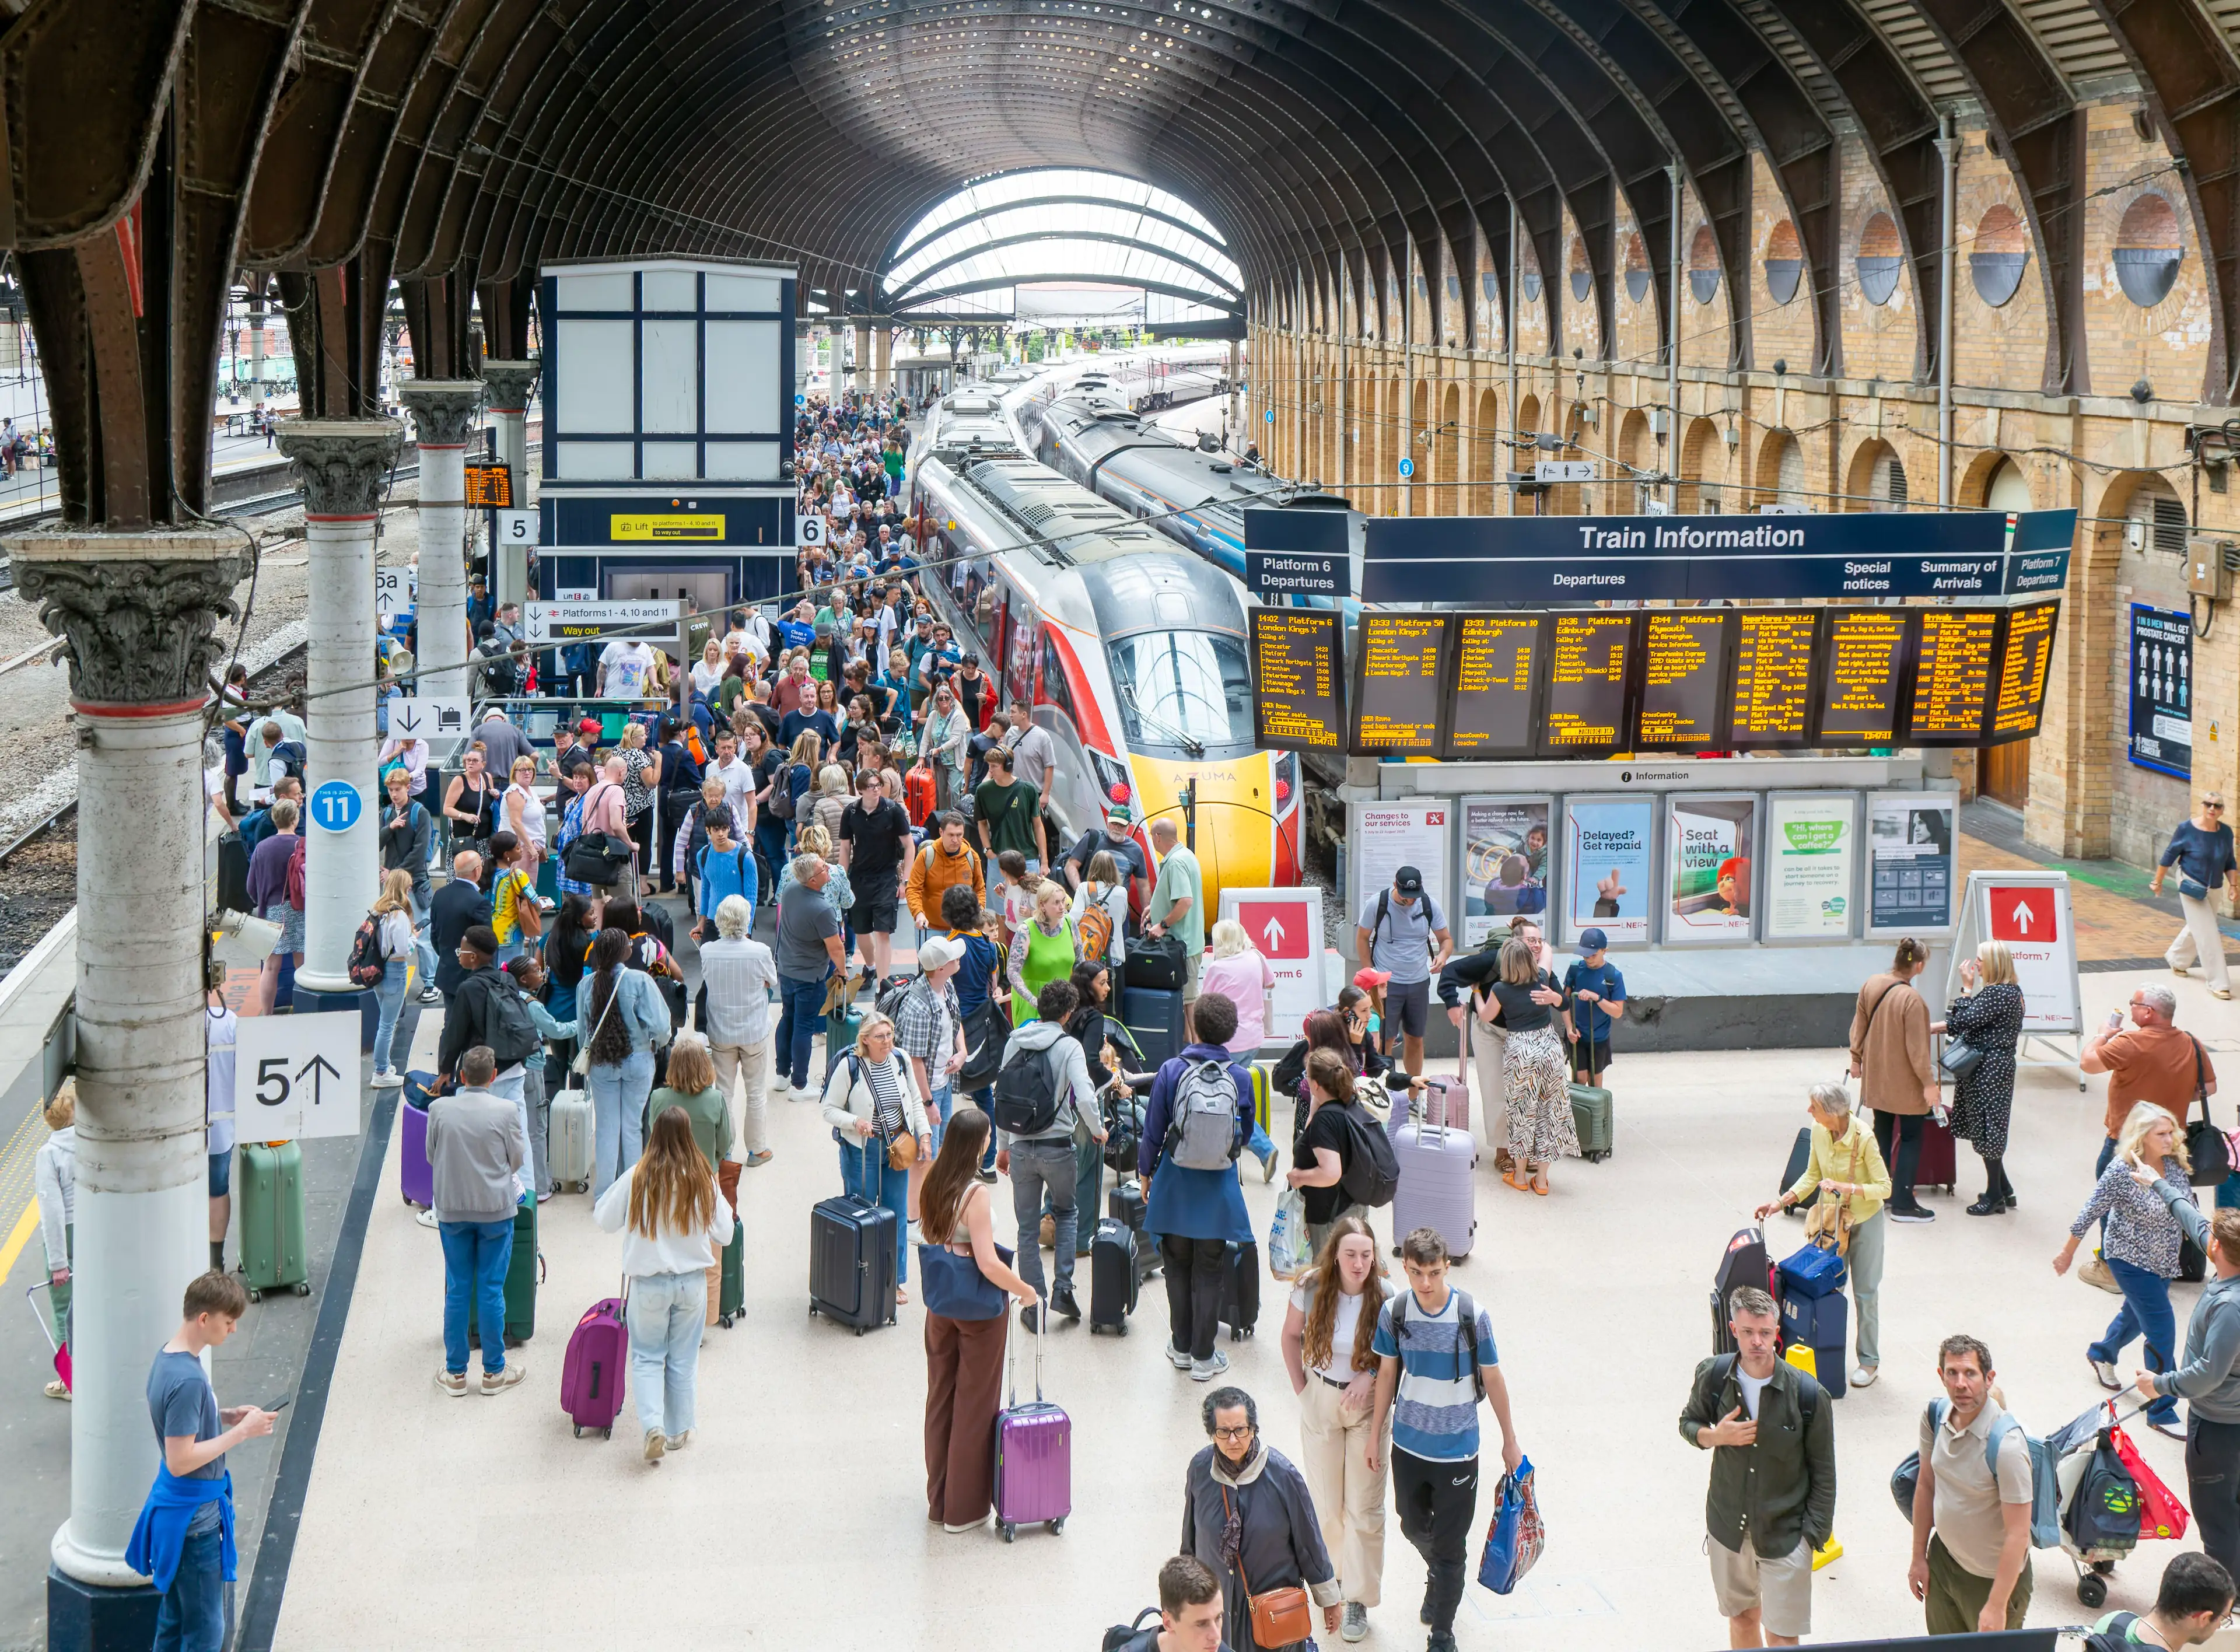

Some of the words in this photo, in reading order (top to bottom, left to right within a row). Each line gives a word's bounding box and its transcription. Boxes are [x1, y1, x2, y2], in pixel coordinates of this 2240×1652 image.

[1404, 464, 1409, 473] 9
[512, 520, 526, 537] 5
[802, 520, 819, 541] 6
[1579, 526, 1646, 549] Train
[1654, 525, 1805, 548] Information
[1263, 558, 1319, 571] Platform
[1323, 561, 1331, 572] 6
[1921, 561, 1980, 574] Summary
[1984, 561, 1997, 572] of
[2021, 558, 2053, 570] Platform
[2054, 556, 2060, 567] 7
[1845, 562, 1891, 576] Special
[377, 572, 397, 589] 5a
[1261, 574, 1334, 589] Departures
[1553, 574, 1625, 587] Departures
[1843, 579, 1889, 589] notices
[1933, 578, 1982, 589] Arrivals
[2017, 574, 2059, 587] Departures
[563, 609, 606, 617] Platforms
[621, 609, 629, 617] 4,
[691, 621, 708, 631] CREW
[1258, 615, 1279, 623] 14:02
[1289, 617, 1325, 626] Platform
[2137, 616, 2140, 624] 1
[2140, 617, 2146, 625] IN
[2151, 619, 2163, 629] MEN
[2164, 621, 2177, 632] WILL
[2178, 625, 2189, 635] GET
[563, 626, 583, 636] Way
[584, 626, 600, 635] out
[1258, 624, 1286, 632] London
[1289, 625, 1310, 634] Kings
[1399, 628, 1420, 637] Kings
[1462, 628, 1503, 637] Edinburgh
[1556, 626, 1595, 635] Edinburgh
[1649, 625, 1685, 634] Plymouth
[2137, 626, 2163, 639] PROSTATE
[2163, 632, 2185, 644] CANCER
[1308, 737, 1338, 746] 13:47:11
[1174, 772, 1236, 783] AZUMA
[322, 797, 348, 822] 11
[1583, 831, 1634, 844] Delayed?
[1686, 830, 1718, 840] Seat
[1813, 833, 1826, 841] get
[1583, 842, 1602, 850] Get
[1605, 841, 1642, 852] repaid
[1685, 842, 1716, 854] with
[1719, 844, 1729, 853] a
[1685, 856, 1718, 867] view
[2011, 951, 2042, 960] atform
[1296, 970, 1302, 978] 6
[256, 1058, 290, 1106] 5
